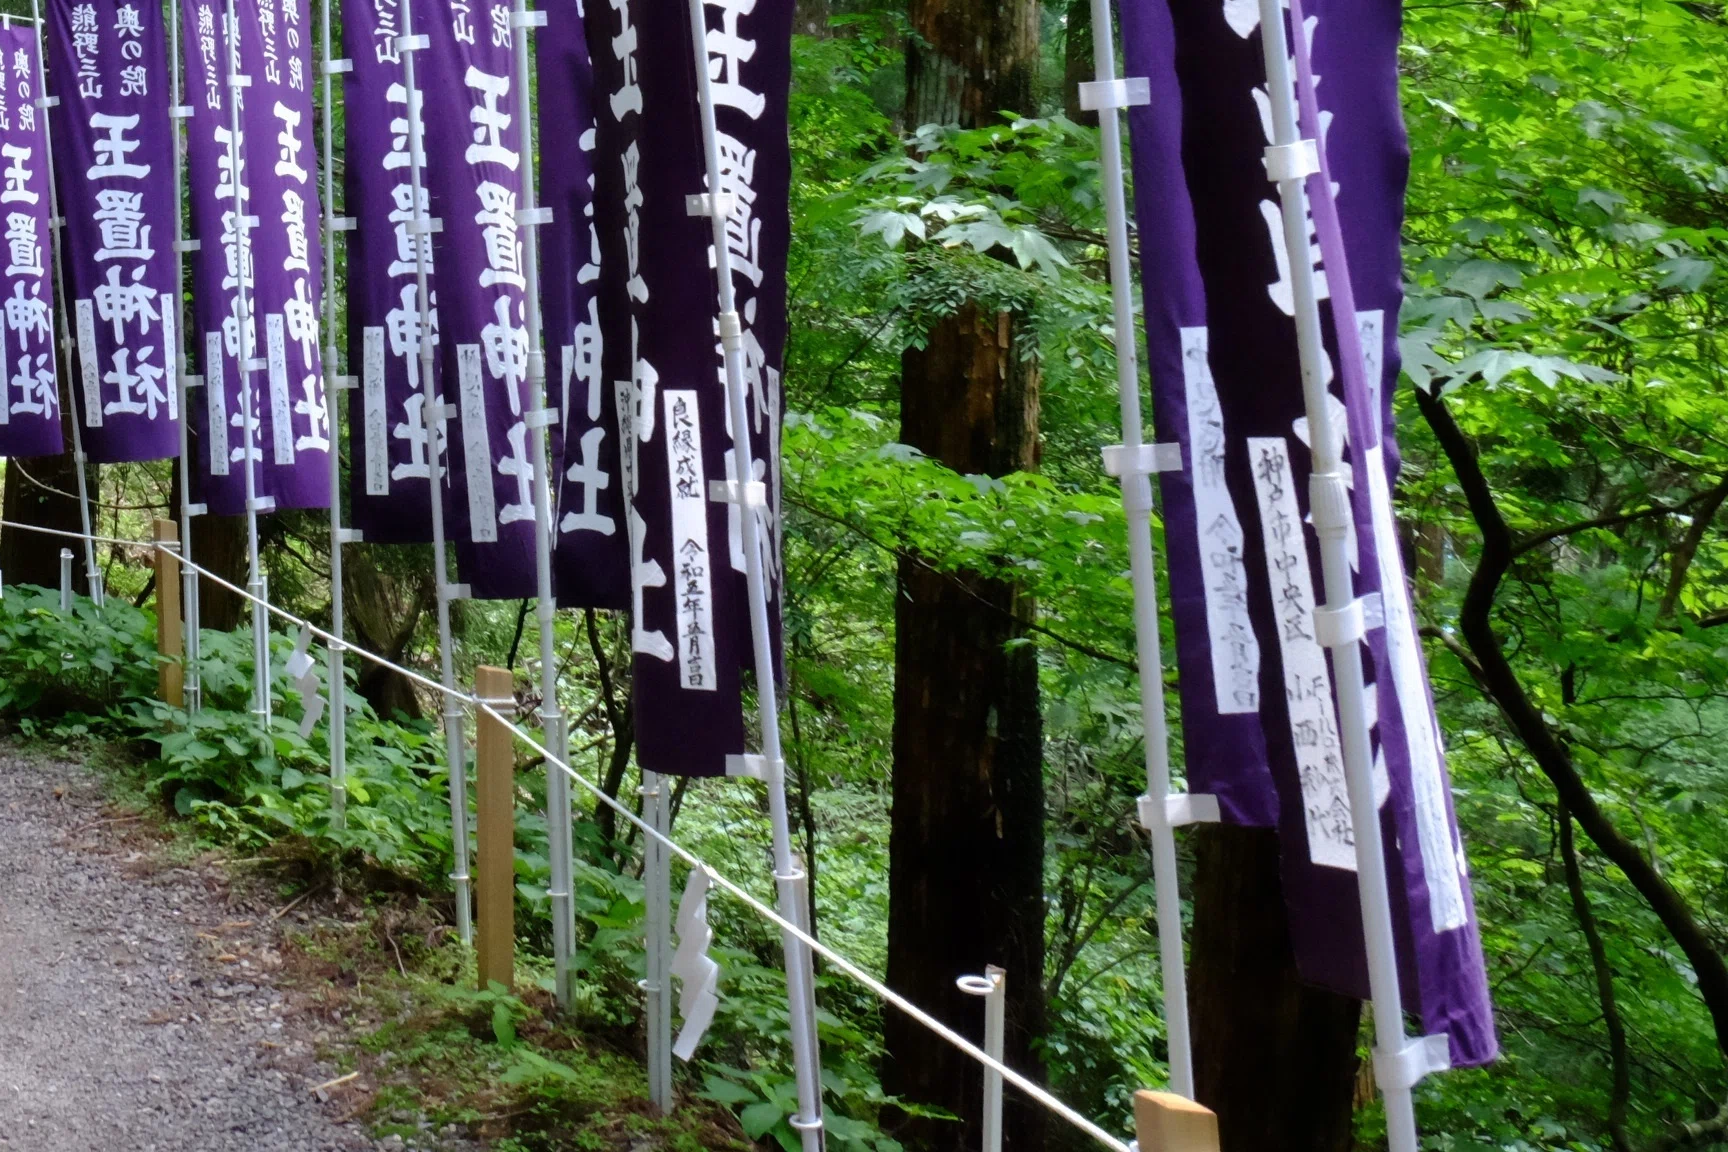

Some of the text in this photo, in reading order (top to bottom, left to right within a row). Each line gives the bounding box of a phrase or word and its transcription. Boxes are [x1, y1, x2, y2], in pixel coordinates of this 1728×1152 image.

[1257, 446, 1313, 643] 神戸市中央区
